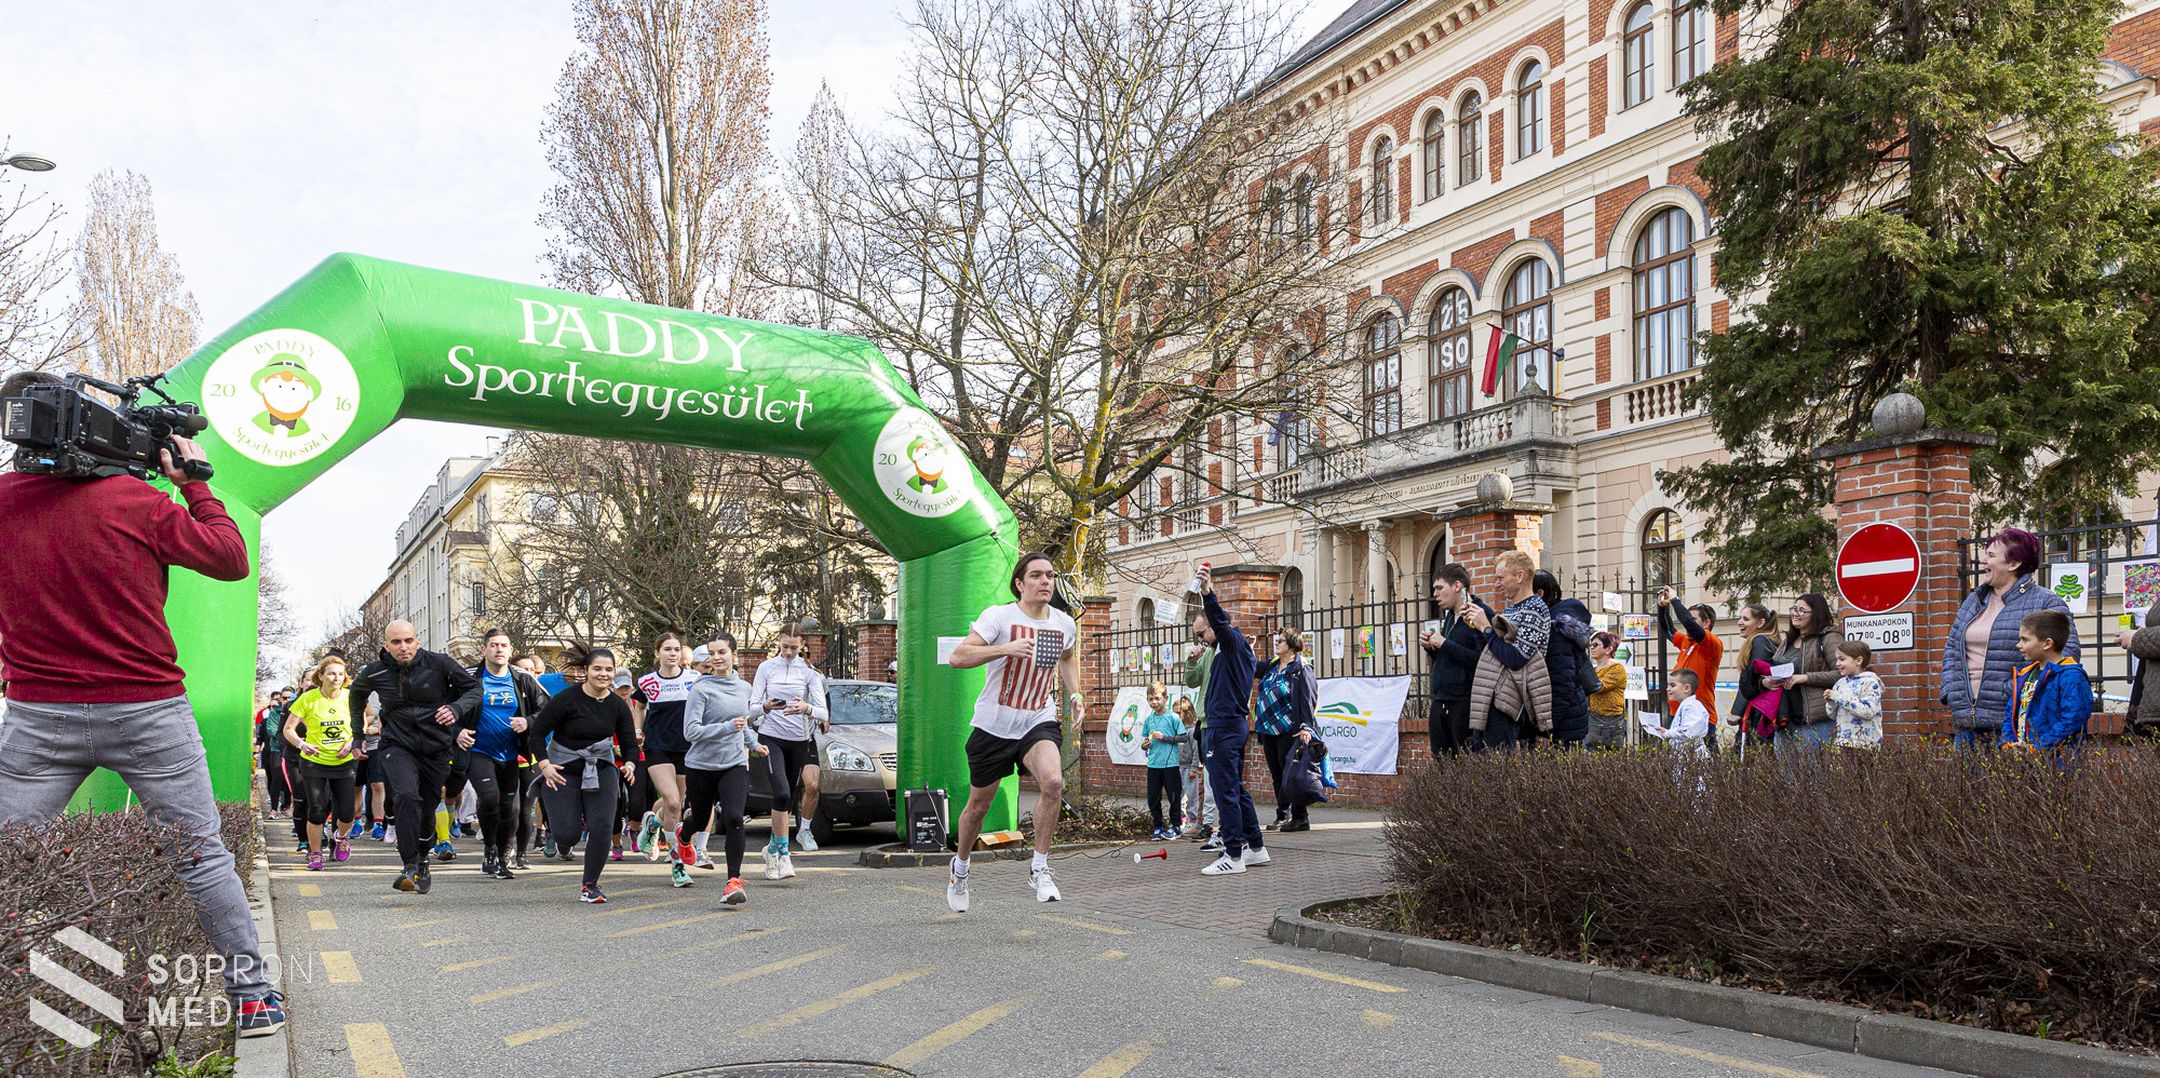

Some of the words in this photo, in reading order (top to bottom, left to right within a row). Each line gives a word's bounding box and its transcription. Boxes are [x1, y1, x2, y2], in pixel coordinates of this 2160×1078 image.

[254, 339, 318, 358] PADDY
[514, 297, 755, 373] PADDY
[1441, 337, 1468, 368] SO
[210, 383, 236, 397] 20
[335, 396, 352, 411] 16
[444, 345, 813, 430] Sportegyesület
[232, 426, 331, 461] Sportegyesület
[878, 453, 897, 466] 20
[1847, 618, 1907, 628] MUNKANAPOKON
